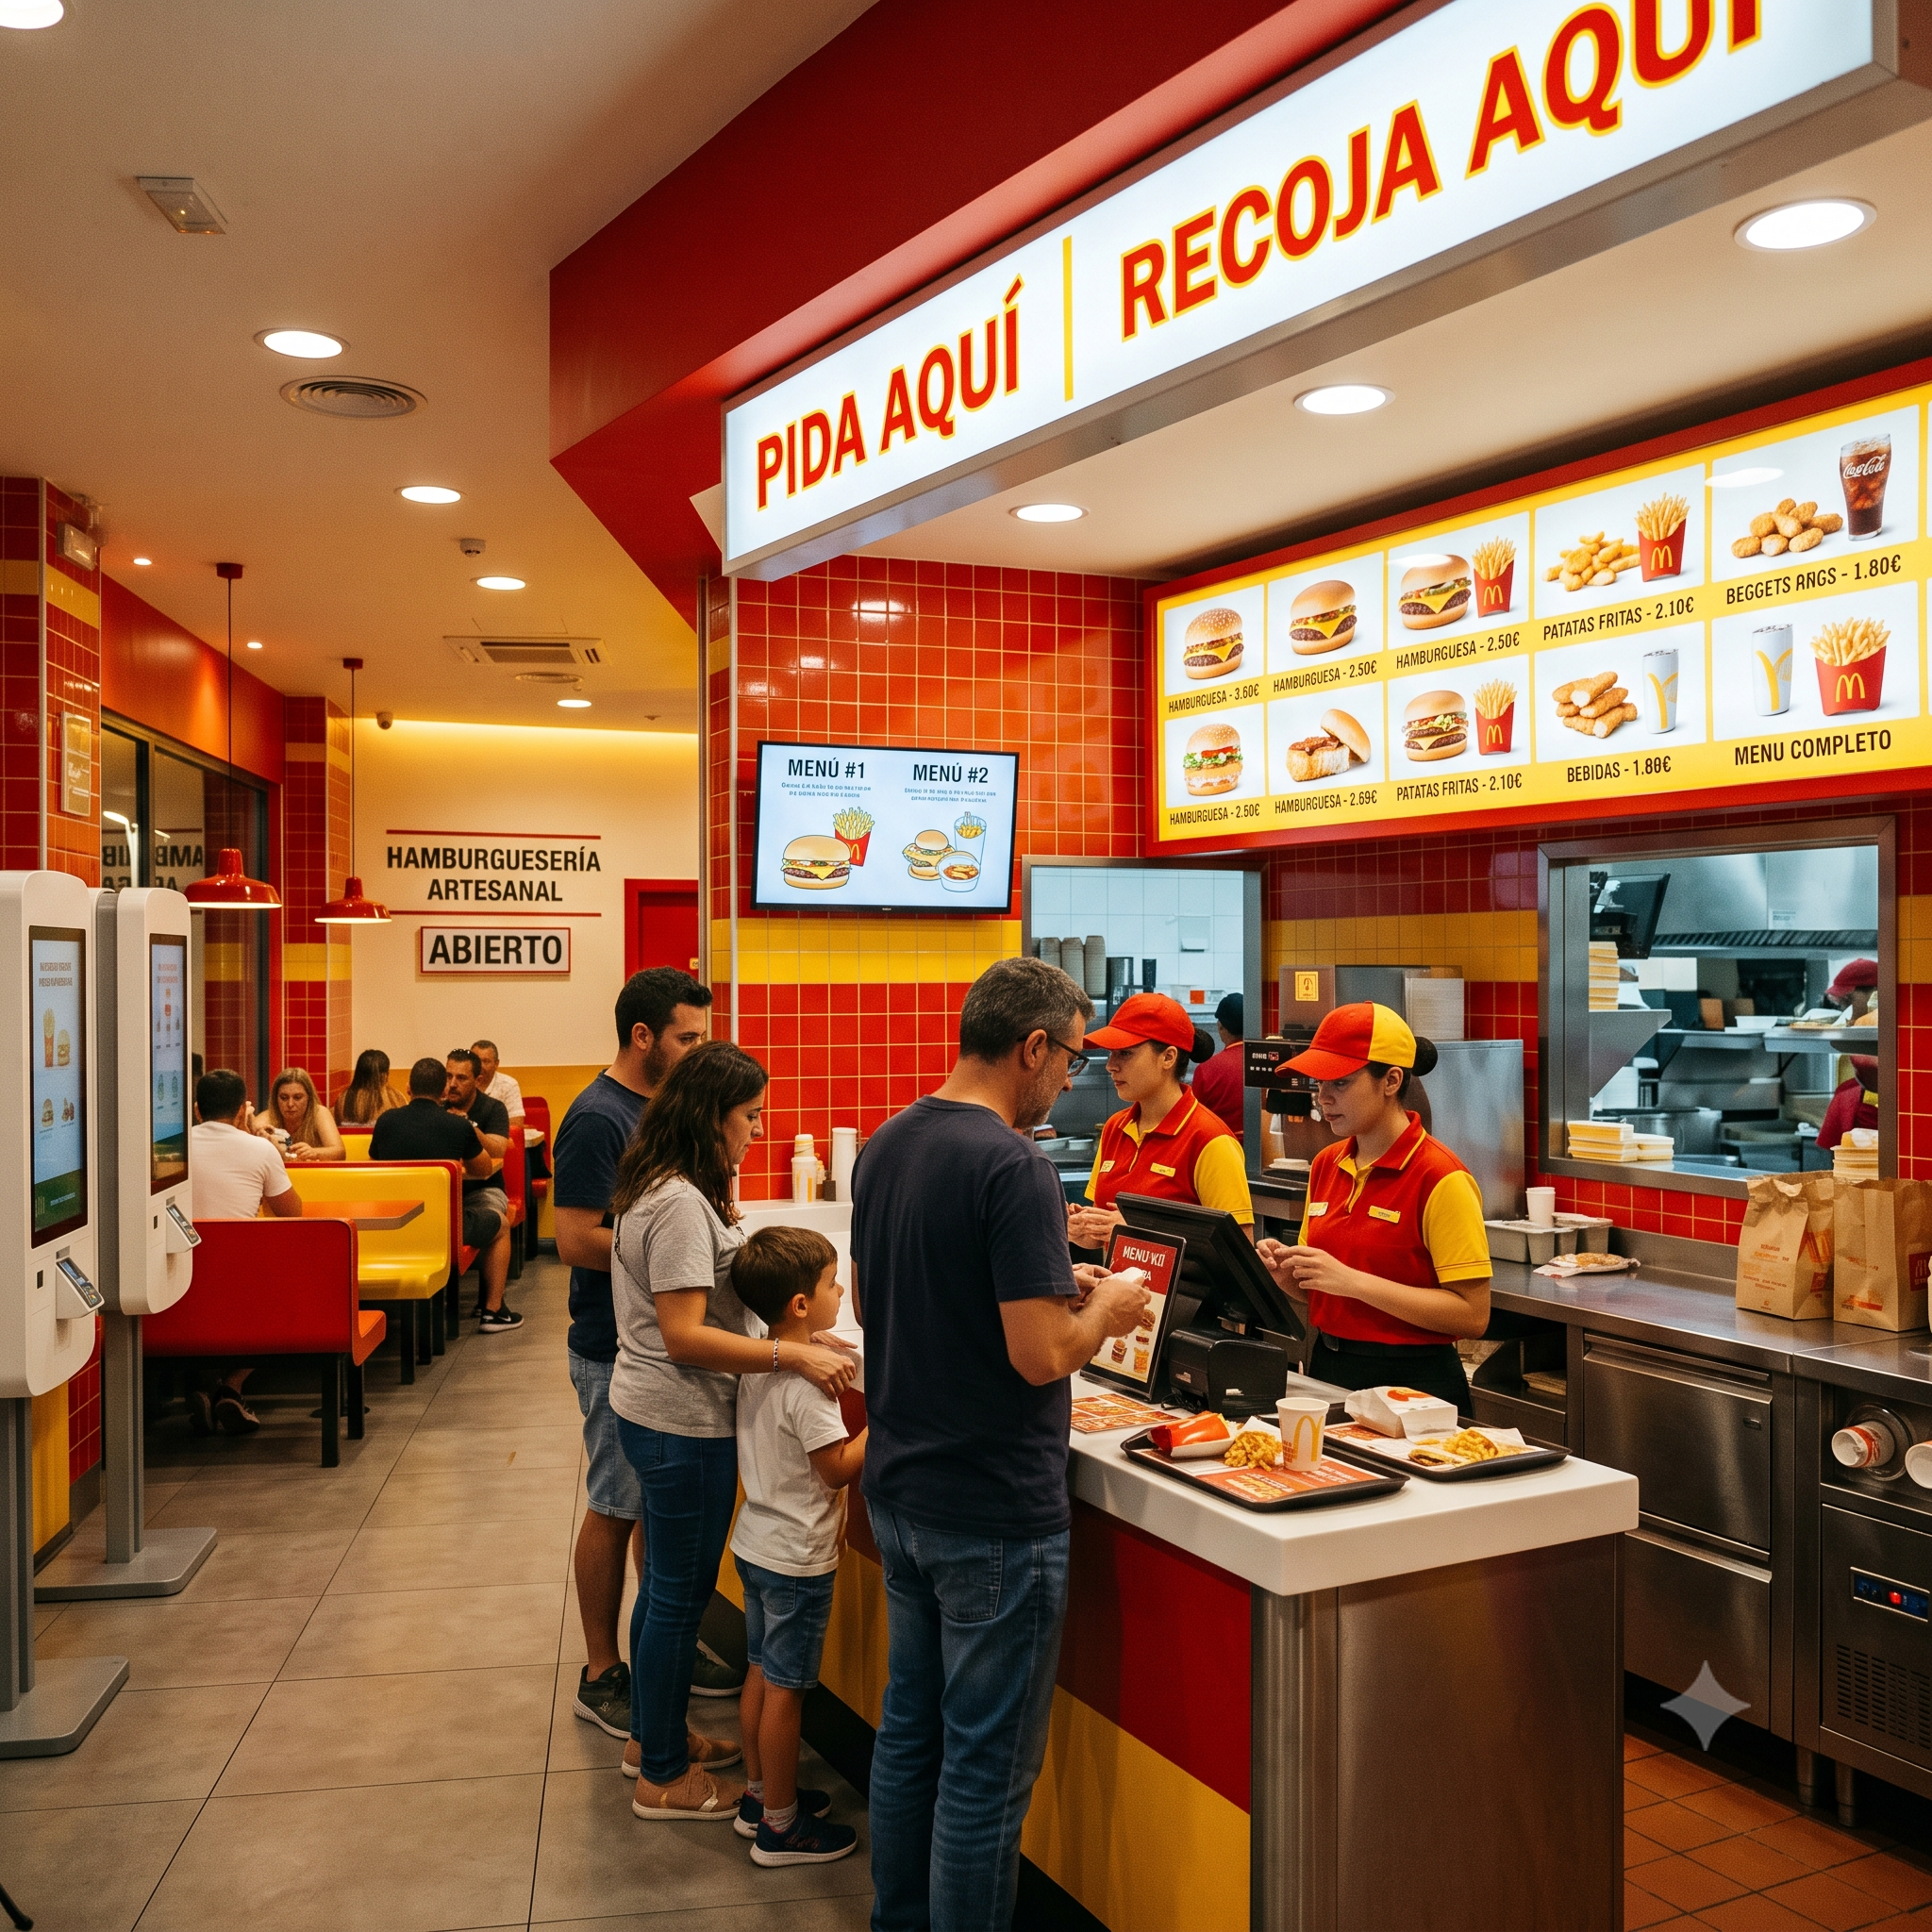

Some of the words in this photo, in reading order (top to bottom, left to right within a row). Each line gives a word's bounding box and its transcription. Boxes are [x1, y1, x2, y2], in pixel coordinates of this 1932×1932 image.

[1121, 98, 1443, 342] RECOJA
[757, 390, 868, 512] PIDA
[878, 272, 1025, 456] AQUÍ
[1726, 575, 1791, 605] BEGGETS
[1854, 554, 1902, 581] 1.80€
[1543, 615, 1594, 641] PATATAS
[1599, 607, 1642, 630] FRITAS
[1656, 596, 1694, 620] 2.10€
[1396, 640, 1476, 669] HAMBURGUESA
[1488, 631, 1521, 652] 2.50€
[1273, 667, 1341, 693] HAMBURGUESA
[1349, 660, 1378, 679] 2.50€
[1169, 690, 1227, 713] HAMBURGUESA
[1234, 683, 1260, 701] 3.60€
[1734, 741, 1785, 766] MENU
[1790, 729, 1892, 760] COMPLETO
[788, 758, 840, 778] MENÚ
[844, 761, 865, 779] #1
[913, 762, 962, 784] MENÚ
[967, 766, 990, 784] #2
[1567, 761, 1621, 783] BEBIDAS
[1396, 782, 1440, 801] PATATAS
[1441, 777, 1479, 796] FRITAS
[1489, 772, 1523, 791] 2.10€
[1170, 807, 1228, 825] HAMBURGUESA
[1235, 803, 1260, 819] 2.50€
[1274, 793, 1341, 814] HAMBURGUESA
[1349, 790, 1378, 807] 2.69€
[387, 845, 602, 873] HAMBURGUESERÍA
[427, 878, 563, 902] ARTESANAL
[428, 934, 563, 965] ABIERTO
[1123, 1245, 1150, 1263] MENU
